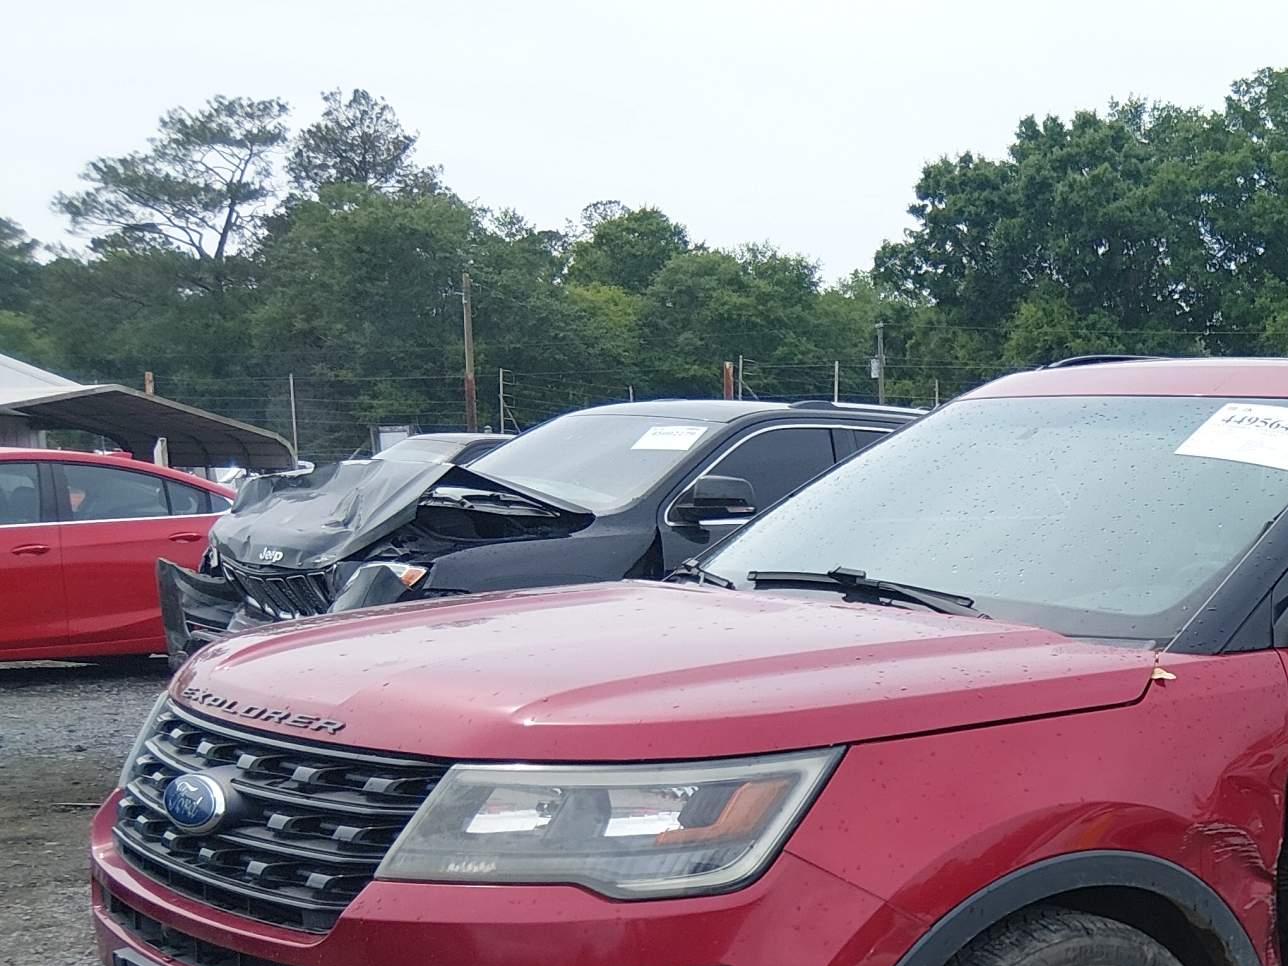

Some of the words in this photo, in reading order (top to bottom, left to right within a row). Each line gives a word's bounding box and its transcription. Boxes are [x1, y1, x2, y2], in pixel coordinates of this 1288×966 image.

[258, 546, 284, 563] Jeep
[182, 686, 347, 736] EXPLORER
[168, 780, 204, 819] Ford
